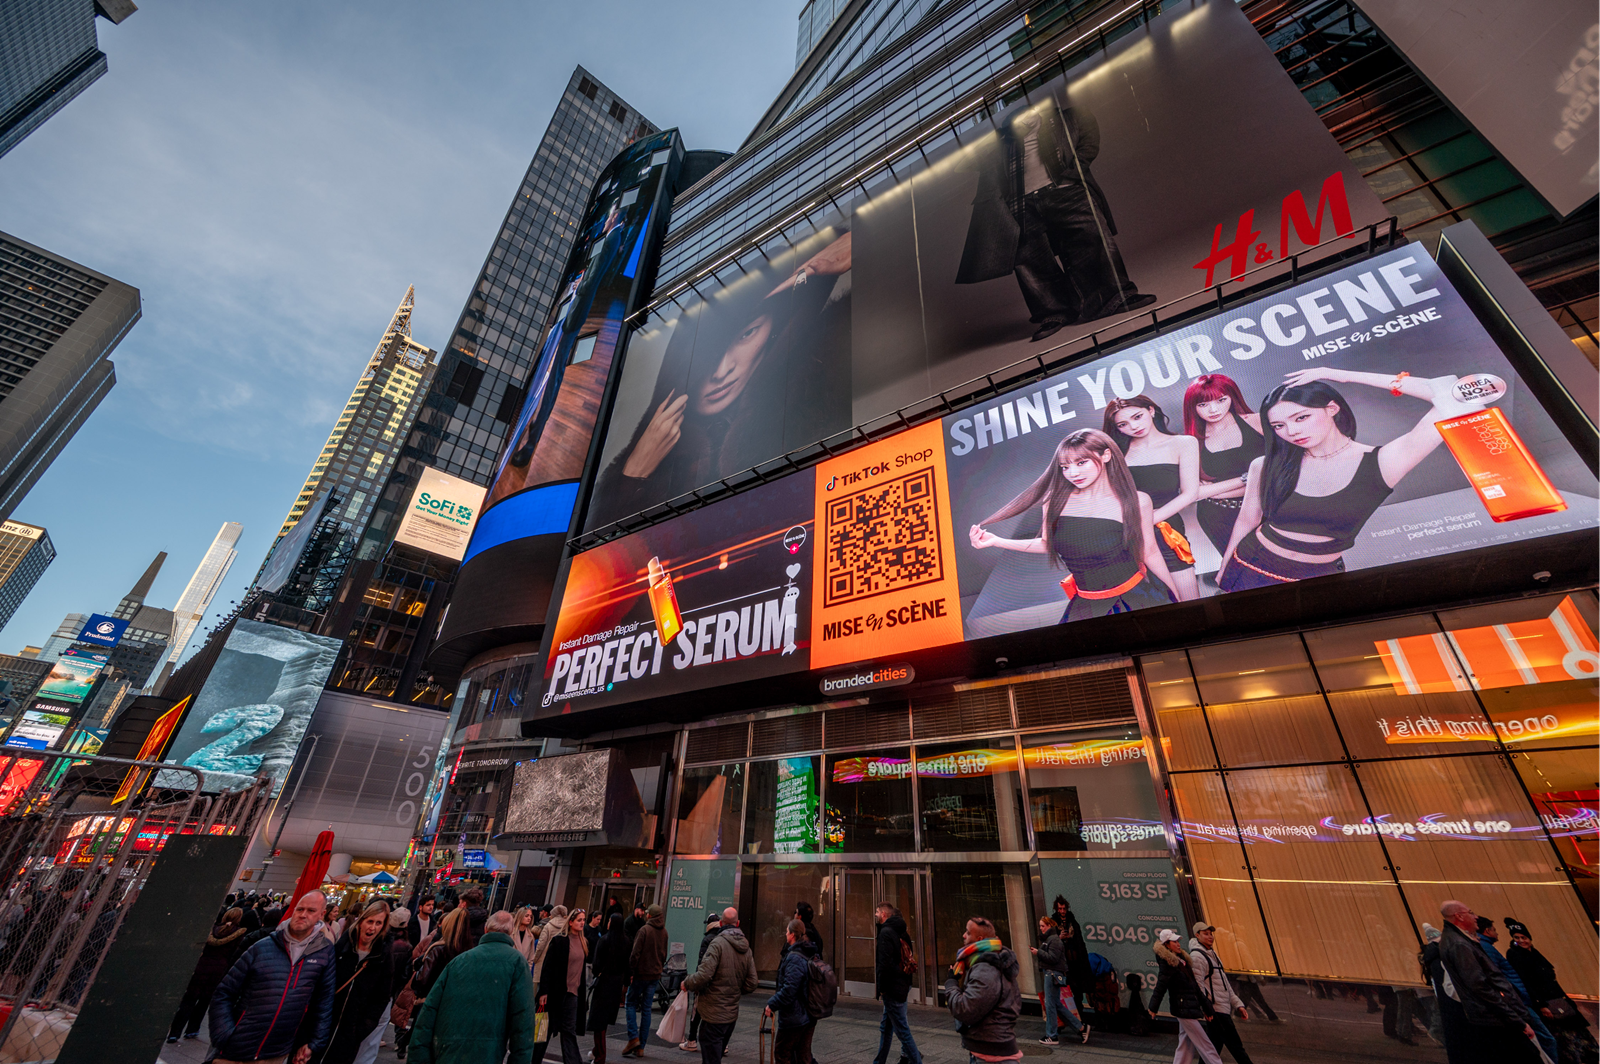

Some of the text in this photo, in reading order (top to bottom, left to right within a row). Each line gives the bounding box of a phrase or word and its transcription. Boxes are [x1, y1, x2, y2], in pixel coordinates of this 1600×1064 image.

[1193, 171, 1355, 293] H&M
[1301, 307, 1442, 361] MISE en SCÈNE
[950, 255, 1441, 456] SHINE YOUR SCENE
[1457, 378, 1492, 391] KOREA
[1442, 422, 1460, 430] MISE
[841, 448, 934, 486] TikTok Shop
[418, 492, 456, 514] SoFi
[438, 512, 455, 522] Money
[1371, 511, 1477, 538] Instant Damage Repair
[1407, 519, 1482, 541] perfect serum
[823, 598, 948, 642] MISE en SCÈNE
[84, 631, 115, 642] Prudential
[559, 621, 640, 650] Instant Damage Repair
[549, 598, 797, 695] PERFECT SERUM
[823, 667, 908, 692] brandedcities
[35, 703, 70, 713] SAMSUNG
[476, 758, 509, 767] TOMORROW
[512, 835, 540, 843] NASDAQ
[676, 867, 684, 878] 4
[1100, 883, 1168, 900] 3,163 SF
[671, 896, 703, 909] RETAIL
[1085, 925, 1149, 944] 25,046
